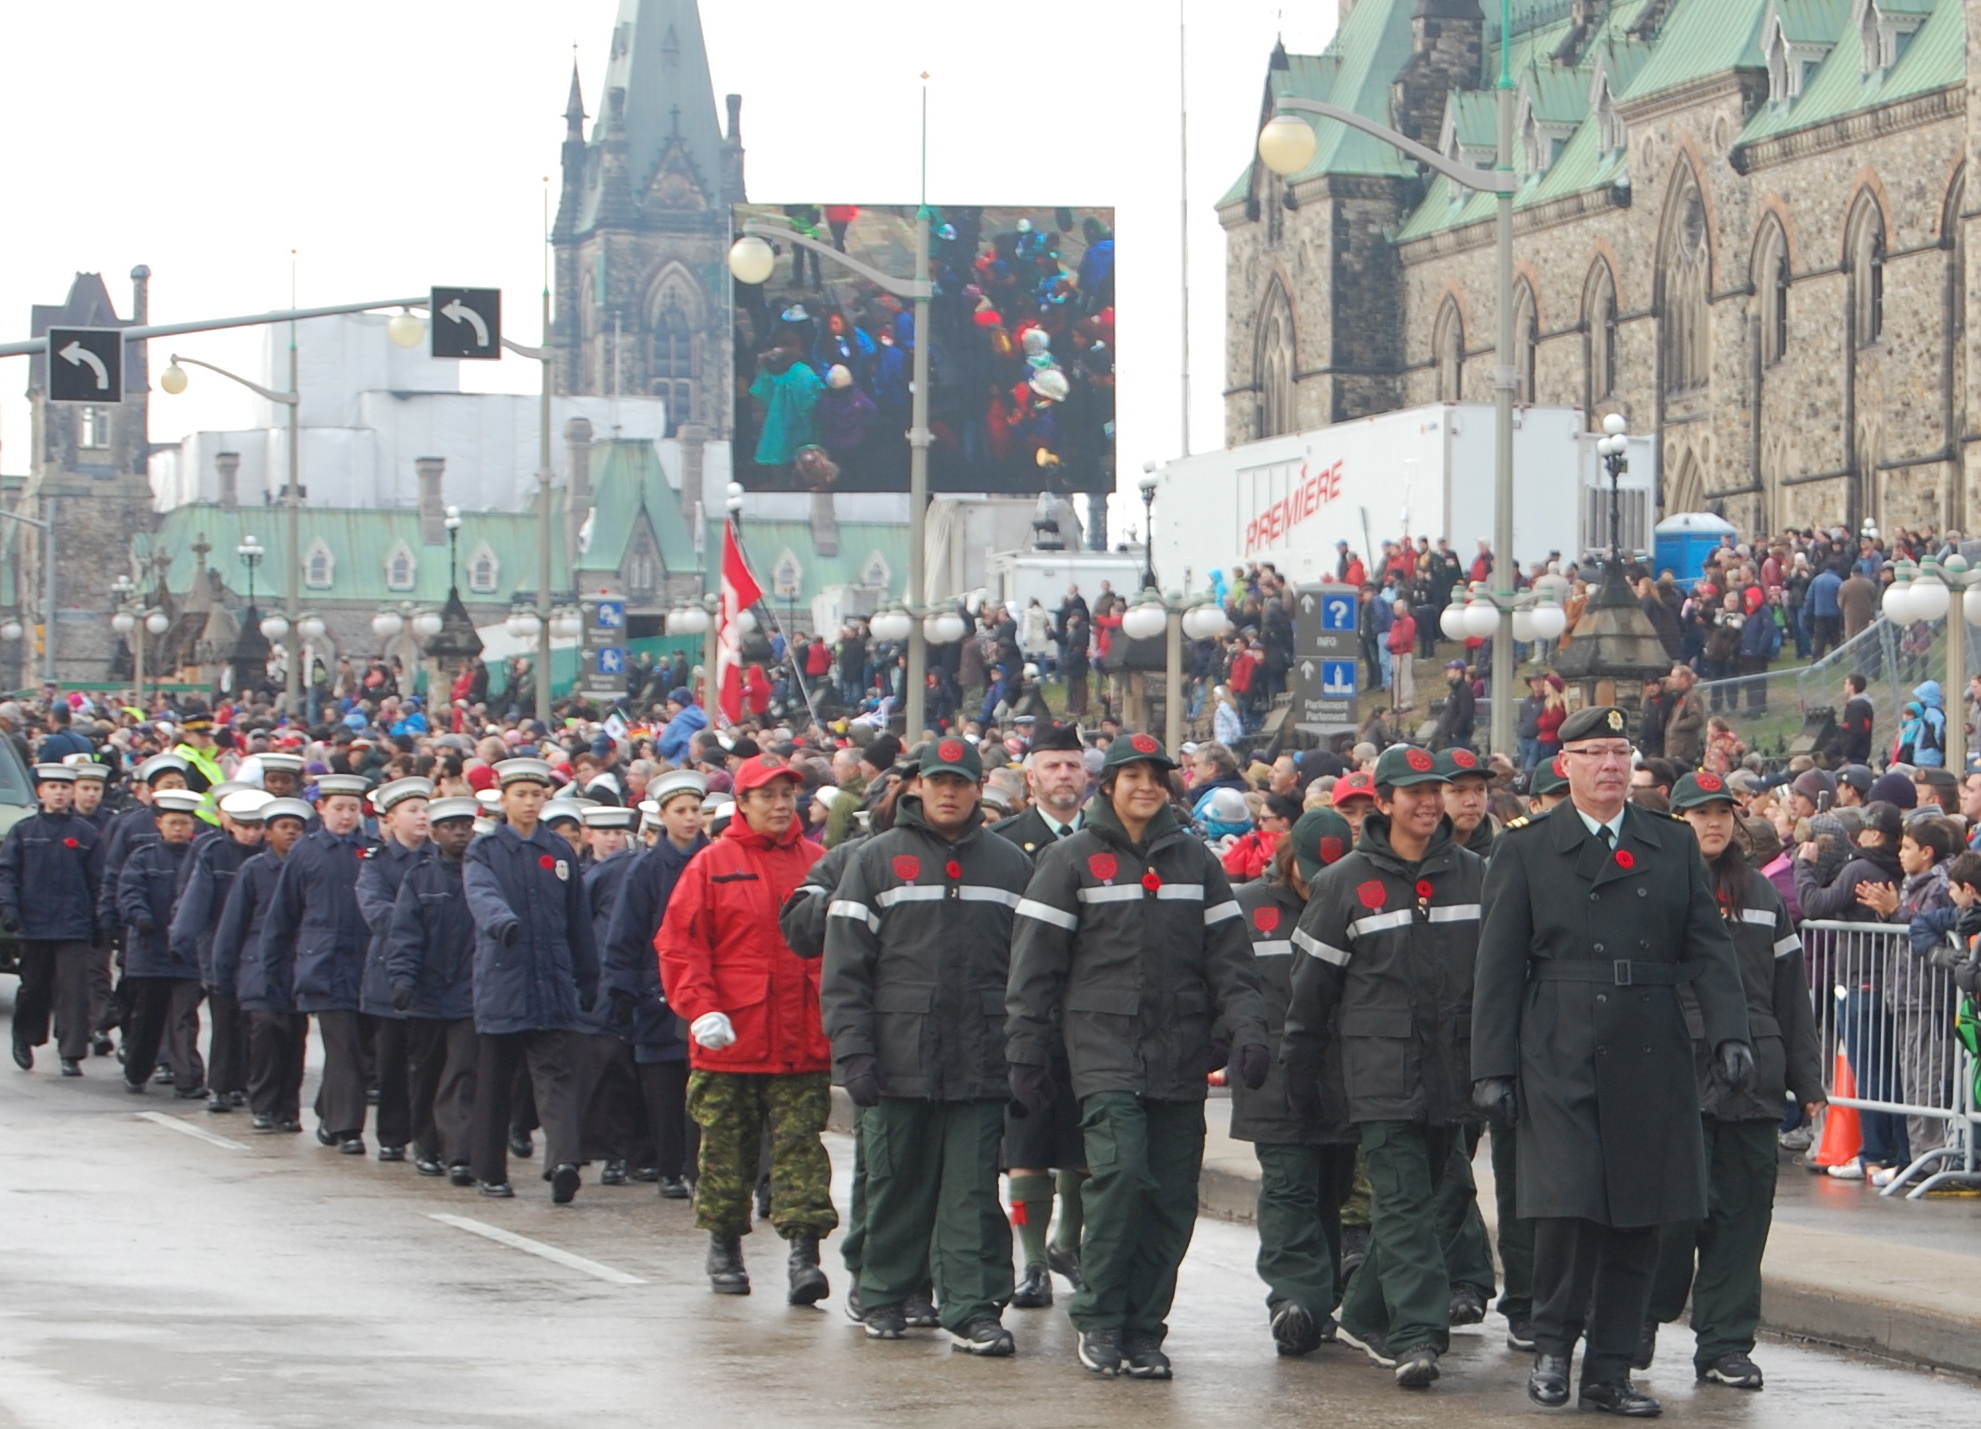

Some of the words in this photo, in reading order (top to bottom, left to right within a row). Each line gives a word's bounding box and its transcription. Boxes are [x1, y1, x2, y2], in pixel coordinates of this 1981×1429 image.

[1317, 636, 1336, 646] INFO
[1305, 699, 1348, 710] Parliament
[1306, 711, 1347, 721] Parlement
